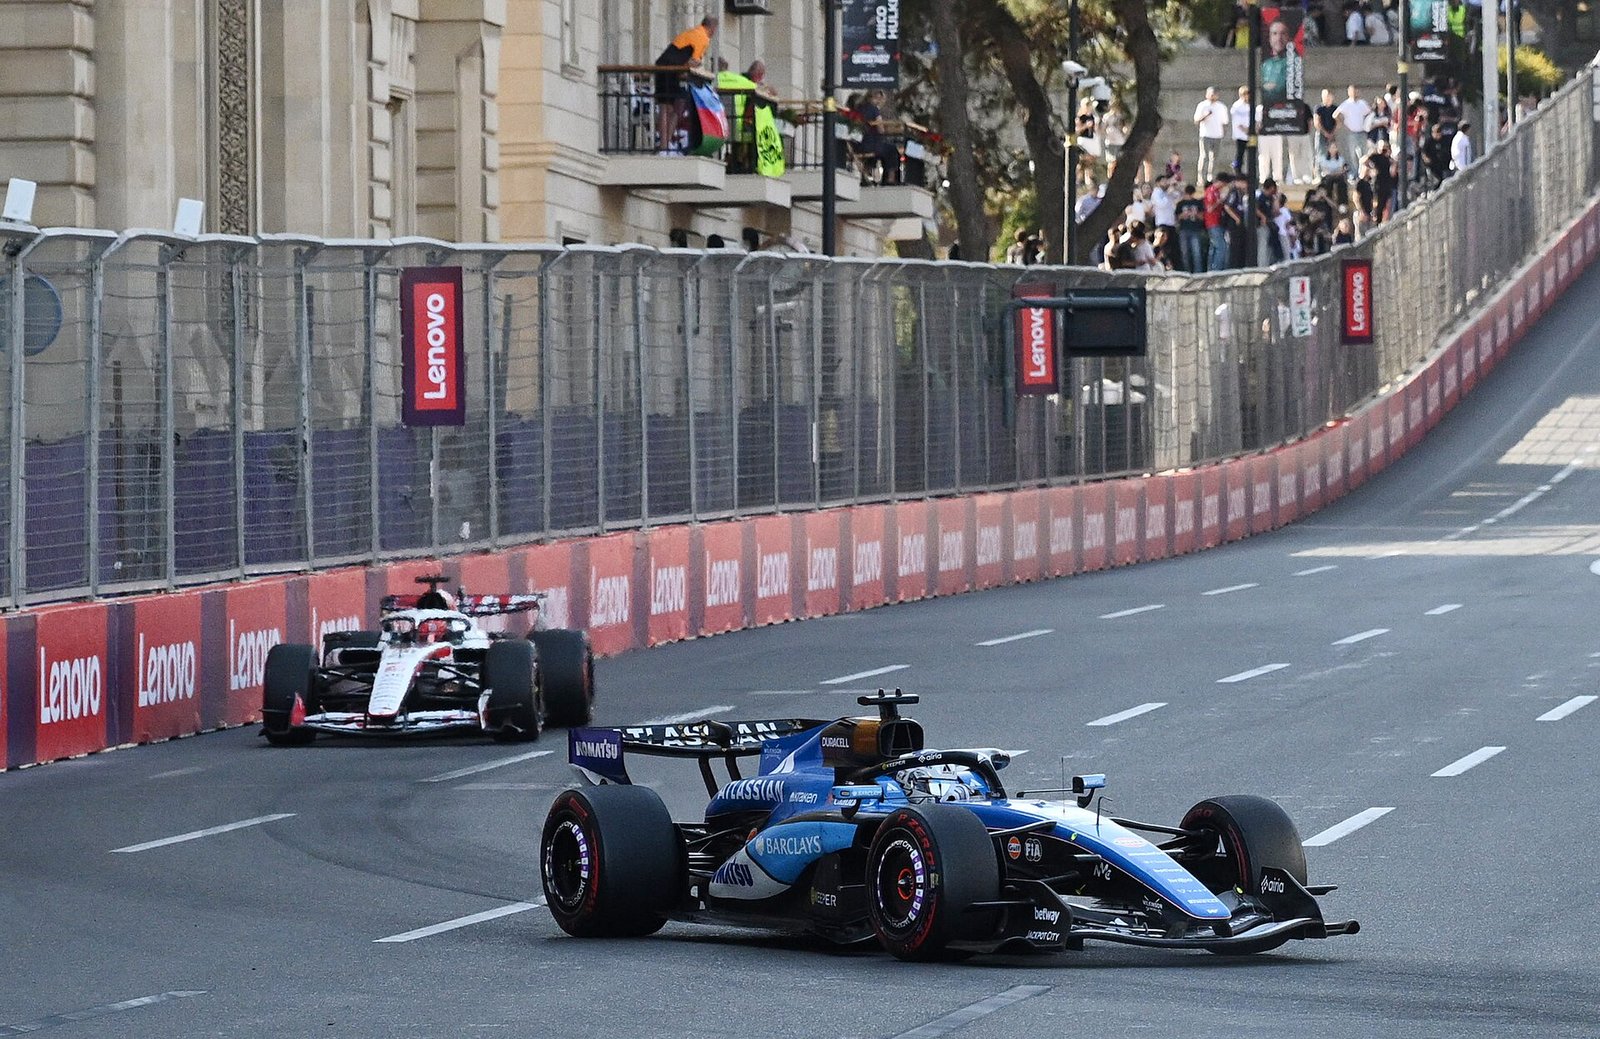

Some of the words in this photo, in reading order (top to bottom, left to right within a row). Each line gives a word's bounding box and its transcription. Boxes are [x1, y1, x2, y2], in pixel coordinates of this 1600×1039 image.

[1351, 272, 1365, 332] Lenovo
[424, 293, 446, 399] Lenovo
[138, 632, 195, 708] Lenovo
[40, 646, 100, 724] Lenovo
[576, 739, 618, 760] KOMATSU
[822, 737, 850, 748] DURACELL
[718, 779, 784, 802] ATLASSIAN
[766, 836, 822, 856] BARCLAYS
[1026, 842, 1040, 857] FIA
[1268, 878, 1284, 893] airia
[1034, 906, 1060, 924] betway
